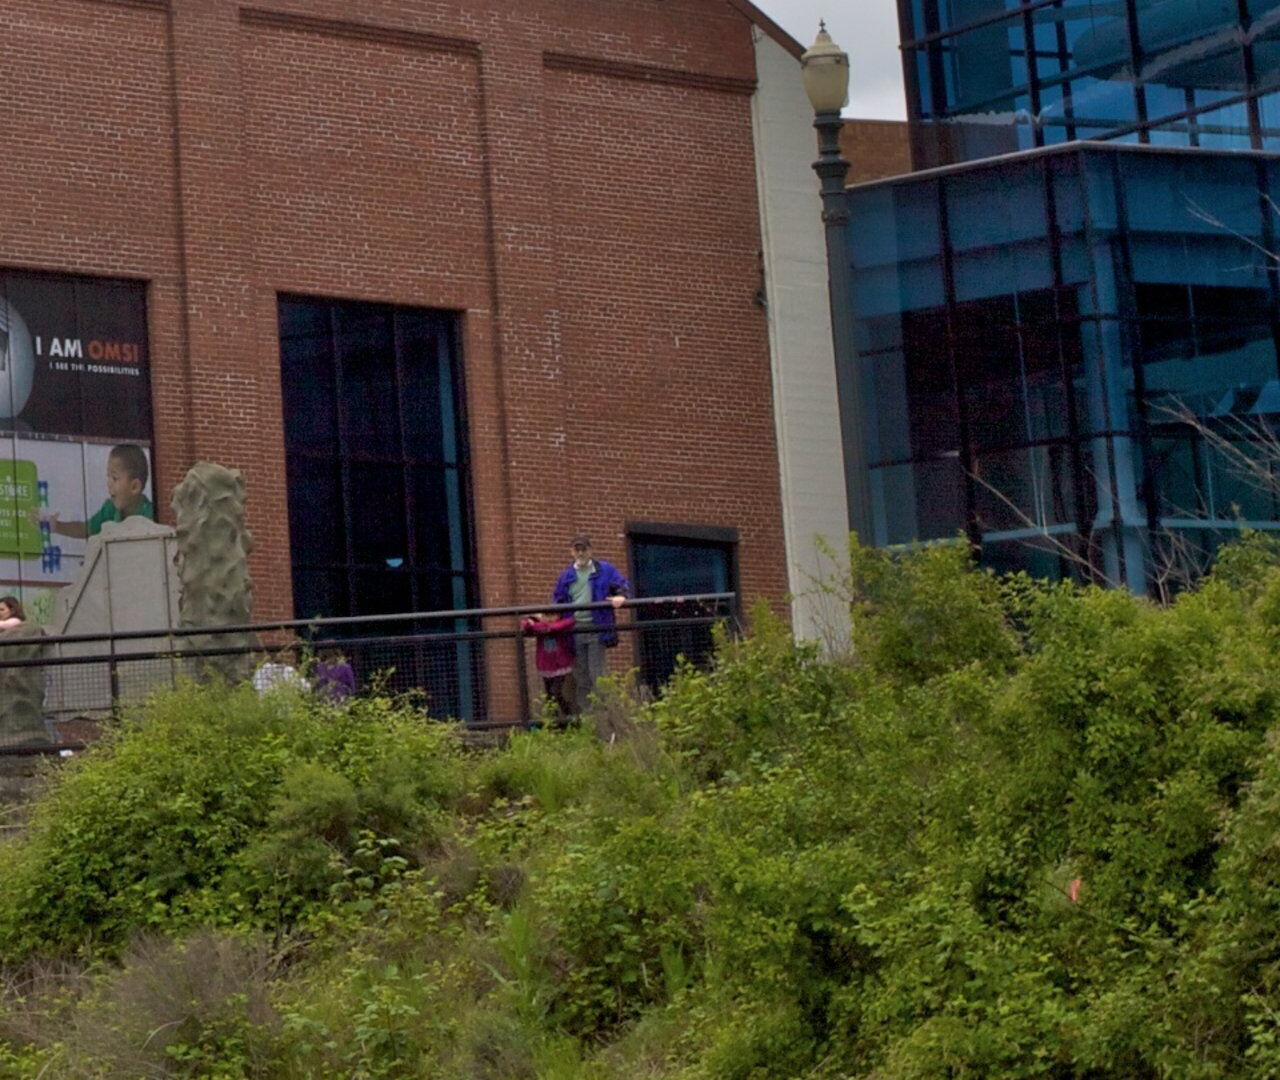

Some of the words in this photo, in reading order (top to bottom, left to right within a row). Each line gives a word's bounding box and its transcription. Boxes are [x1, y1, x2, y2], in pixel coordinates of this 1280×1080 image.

[35, 336, 42, 356] I
[49, 337, 83, 358] AM
[87, 340, 139, 363] OMSI
[55, 362, 68, 371] SEE
[87, 364, 139, 376] POSSIBILITIES
